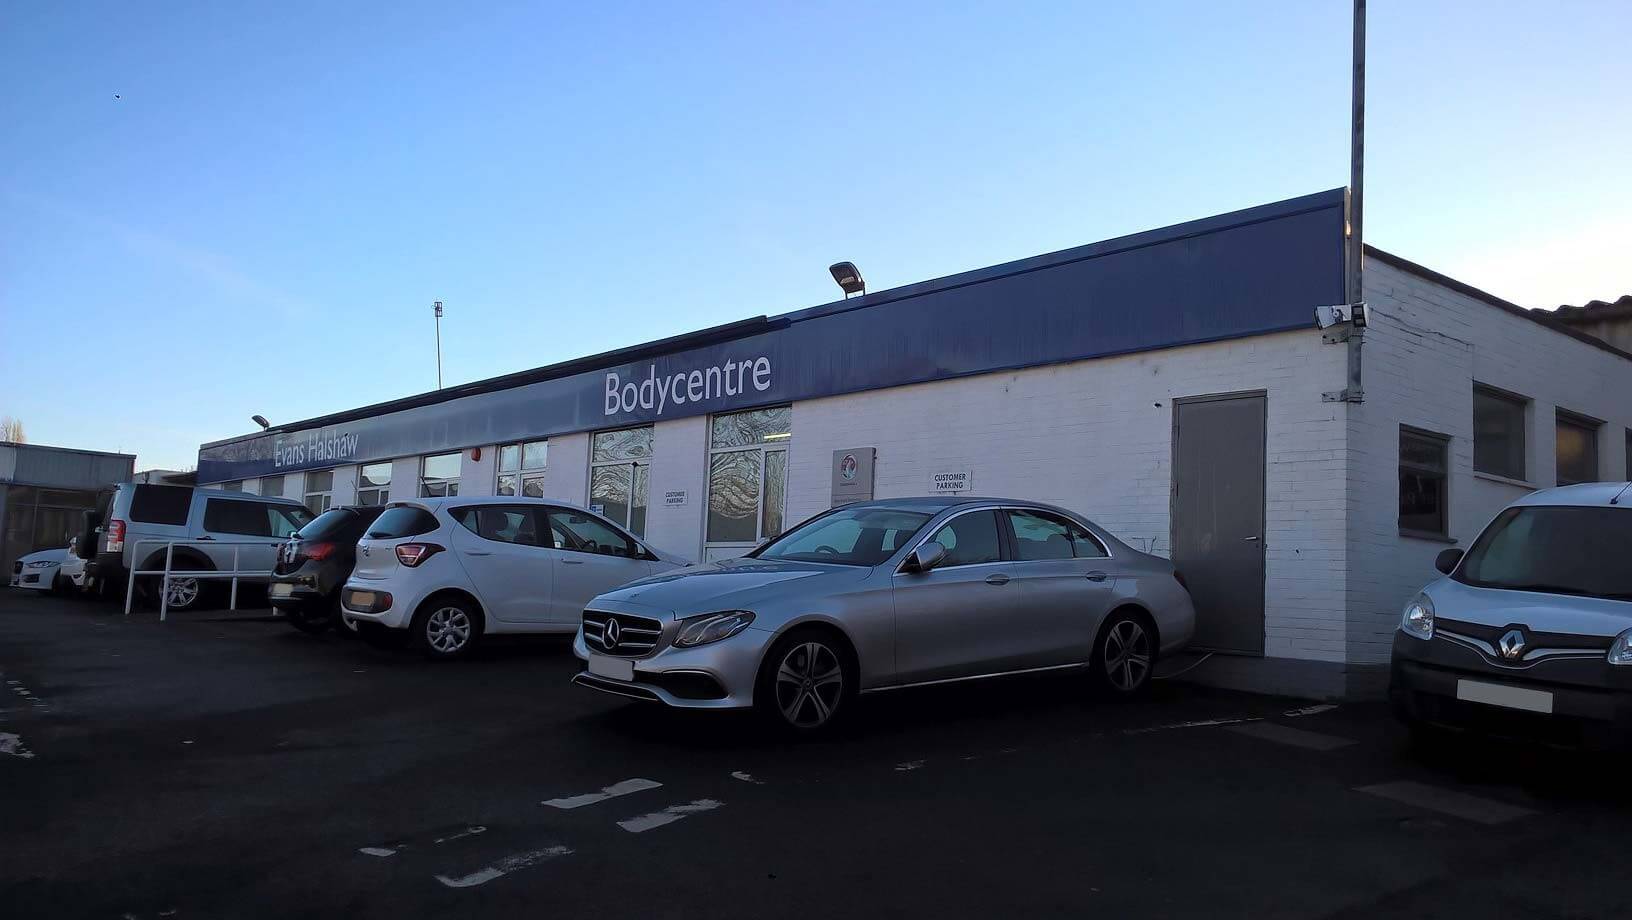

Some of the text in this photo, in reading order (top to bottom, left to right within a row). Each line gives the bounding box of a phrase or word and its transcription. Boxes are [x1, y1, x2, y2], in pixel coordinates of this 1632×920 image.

[604, 356, 771, 416] Bodycentre
[275, 430, 358, 467] Evans Halshaw
[934, 473, 966, 481] CUSTOMER
[936, 481, 963, 490] PARKING
